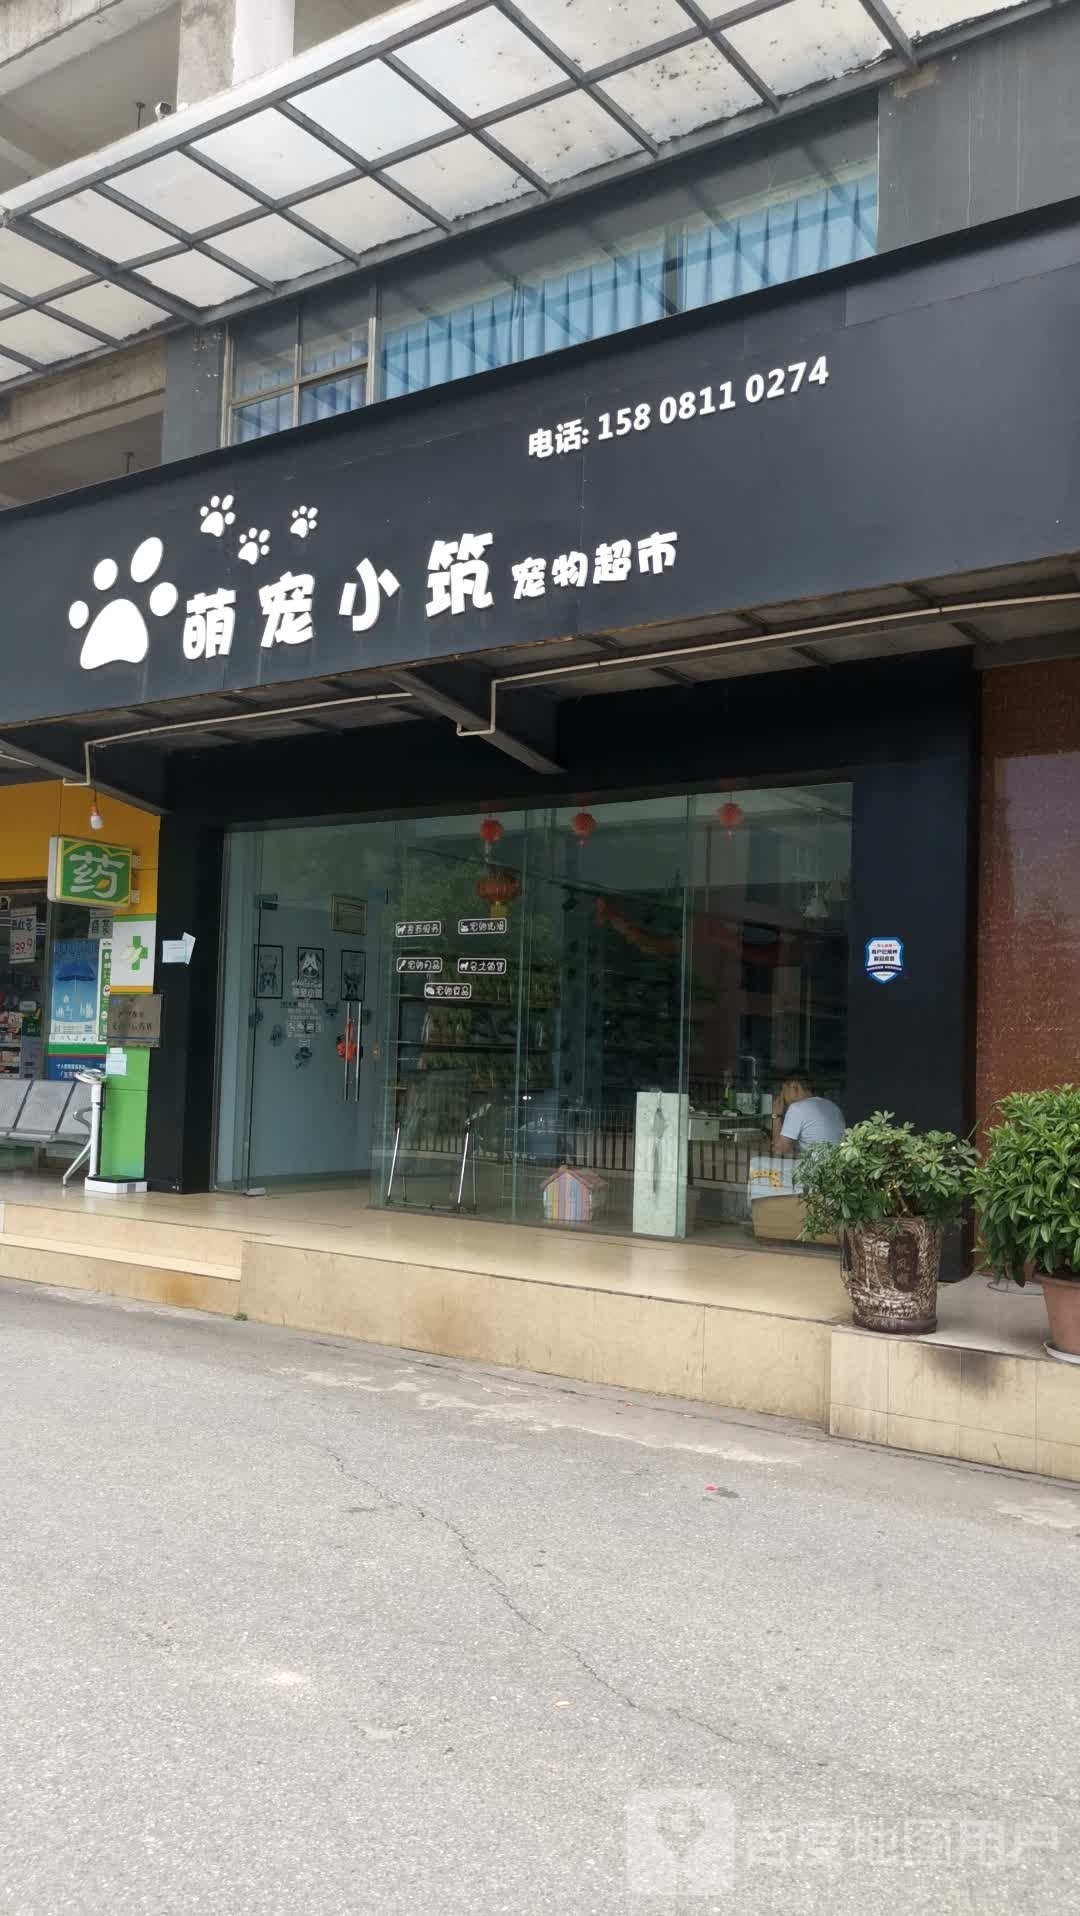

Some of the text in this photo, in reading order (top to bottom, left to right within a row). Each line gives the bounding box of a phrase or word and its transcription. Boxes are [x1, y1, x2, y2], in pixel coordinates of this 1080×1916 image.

[597, 403, 652, 441] 158
[659, 381, 737, 424] 0811
[745, 355, 830, 403] 0274
[182, 532, 495, 660] 萌宠小筑
[511, 531, 679, 601] 宠物超市
[68, 850, 126, 899] 药
